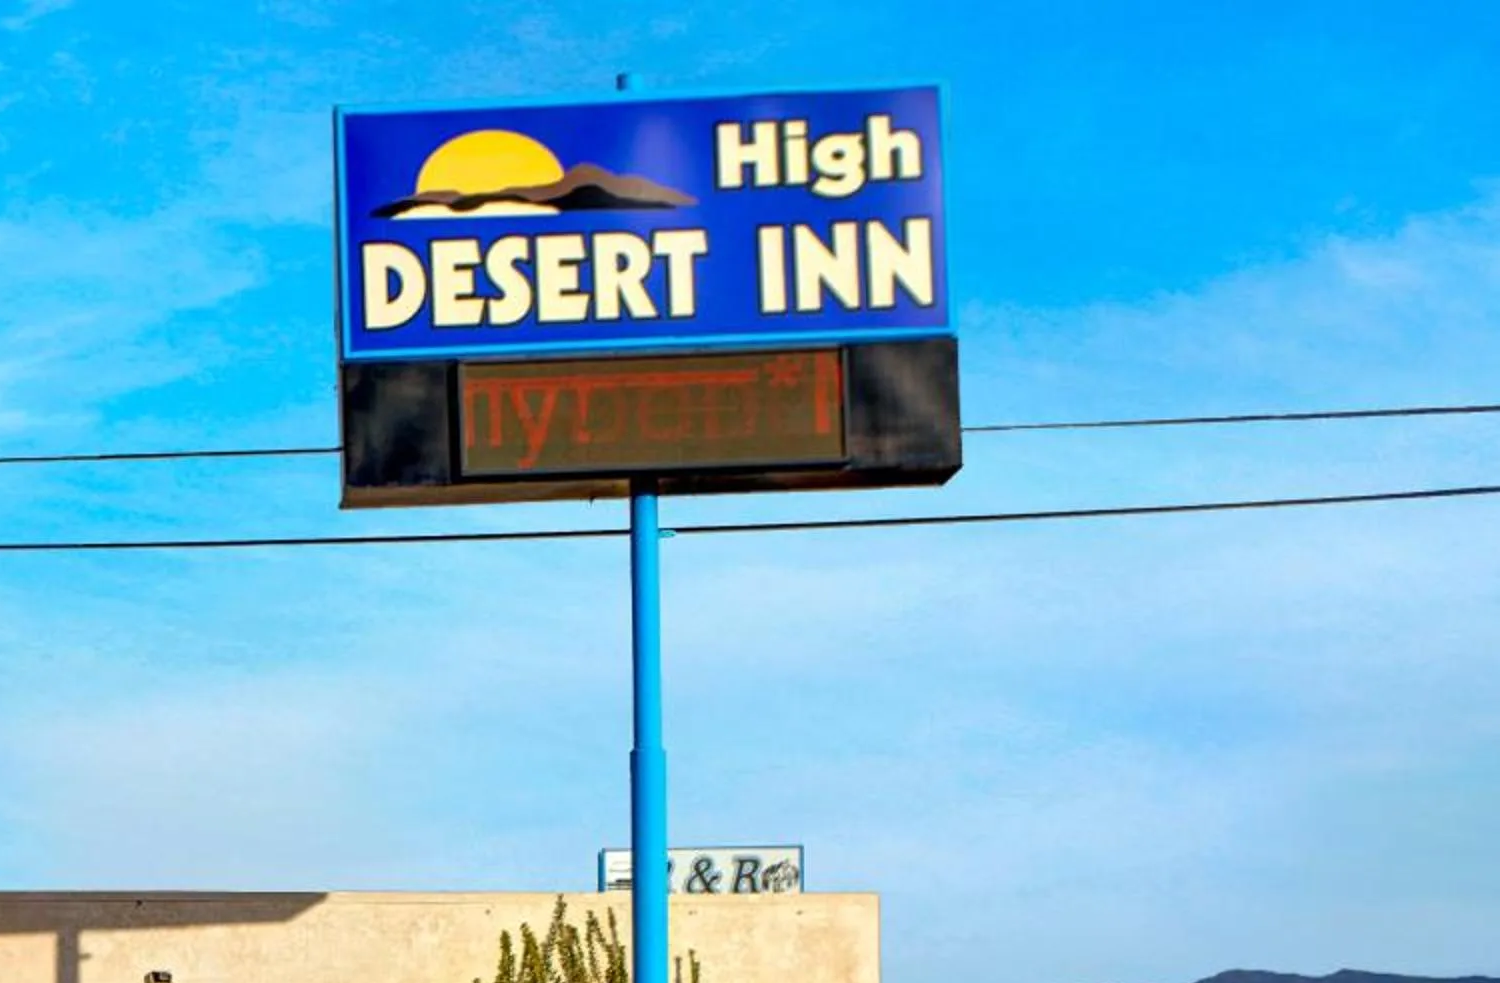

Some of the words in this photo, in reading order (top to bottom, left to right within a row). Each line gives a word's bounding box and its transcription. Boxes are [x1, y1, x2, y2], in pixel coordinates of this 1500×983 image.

[714, 114, 922, 198] High
[360, 229, 709, 330] DESERT
[756, 216, 934, 314] INN
[685, 856, 722, 893] &
[731, 855, 762, 893] R
